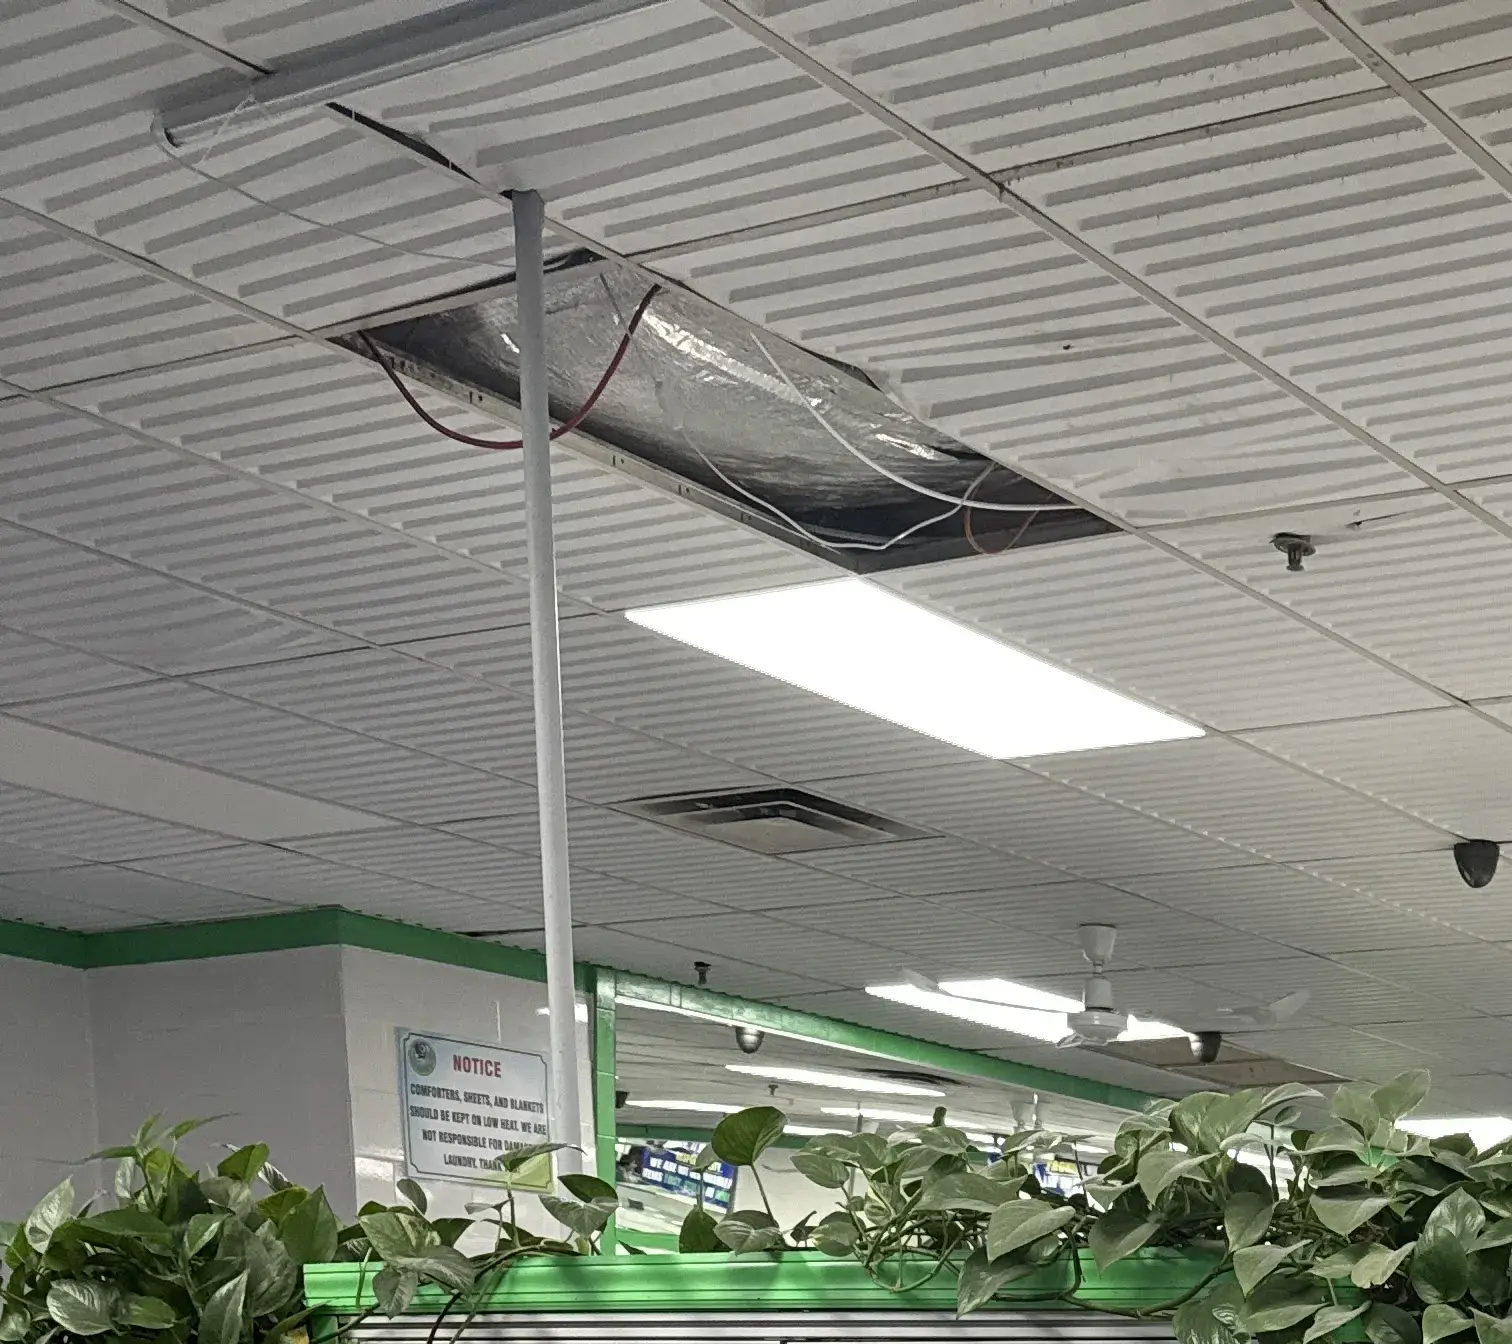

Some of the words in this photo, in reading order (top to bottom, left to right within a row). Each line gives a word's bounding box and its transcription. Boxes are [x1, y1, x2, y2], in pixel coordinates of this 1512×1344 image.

[453, 1055, 501, 1078] NOTICE
[494, 1096, 508, 1108] AND
[410, 1106, 438, 1119] SHOULD
[441, 1110, 449, 1121] BE
[452, 1112, 469, 1123] KEPT
[472, 1115, 481, 1126] ON
[484, 1117, 498, 1128] LOW
[521, 1122, 531, 1133] WE
[534, 1124, 546, 1135] ARE
[422, 1129, 436, 1141] NOT
[439, 1131, 486, 1148] RESPONSIBLE
[489, 1138, 502, 1150] FOR
[444, 1154, 476, 1168] LAUNDRY.
